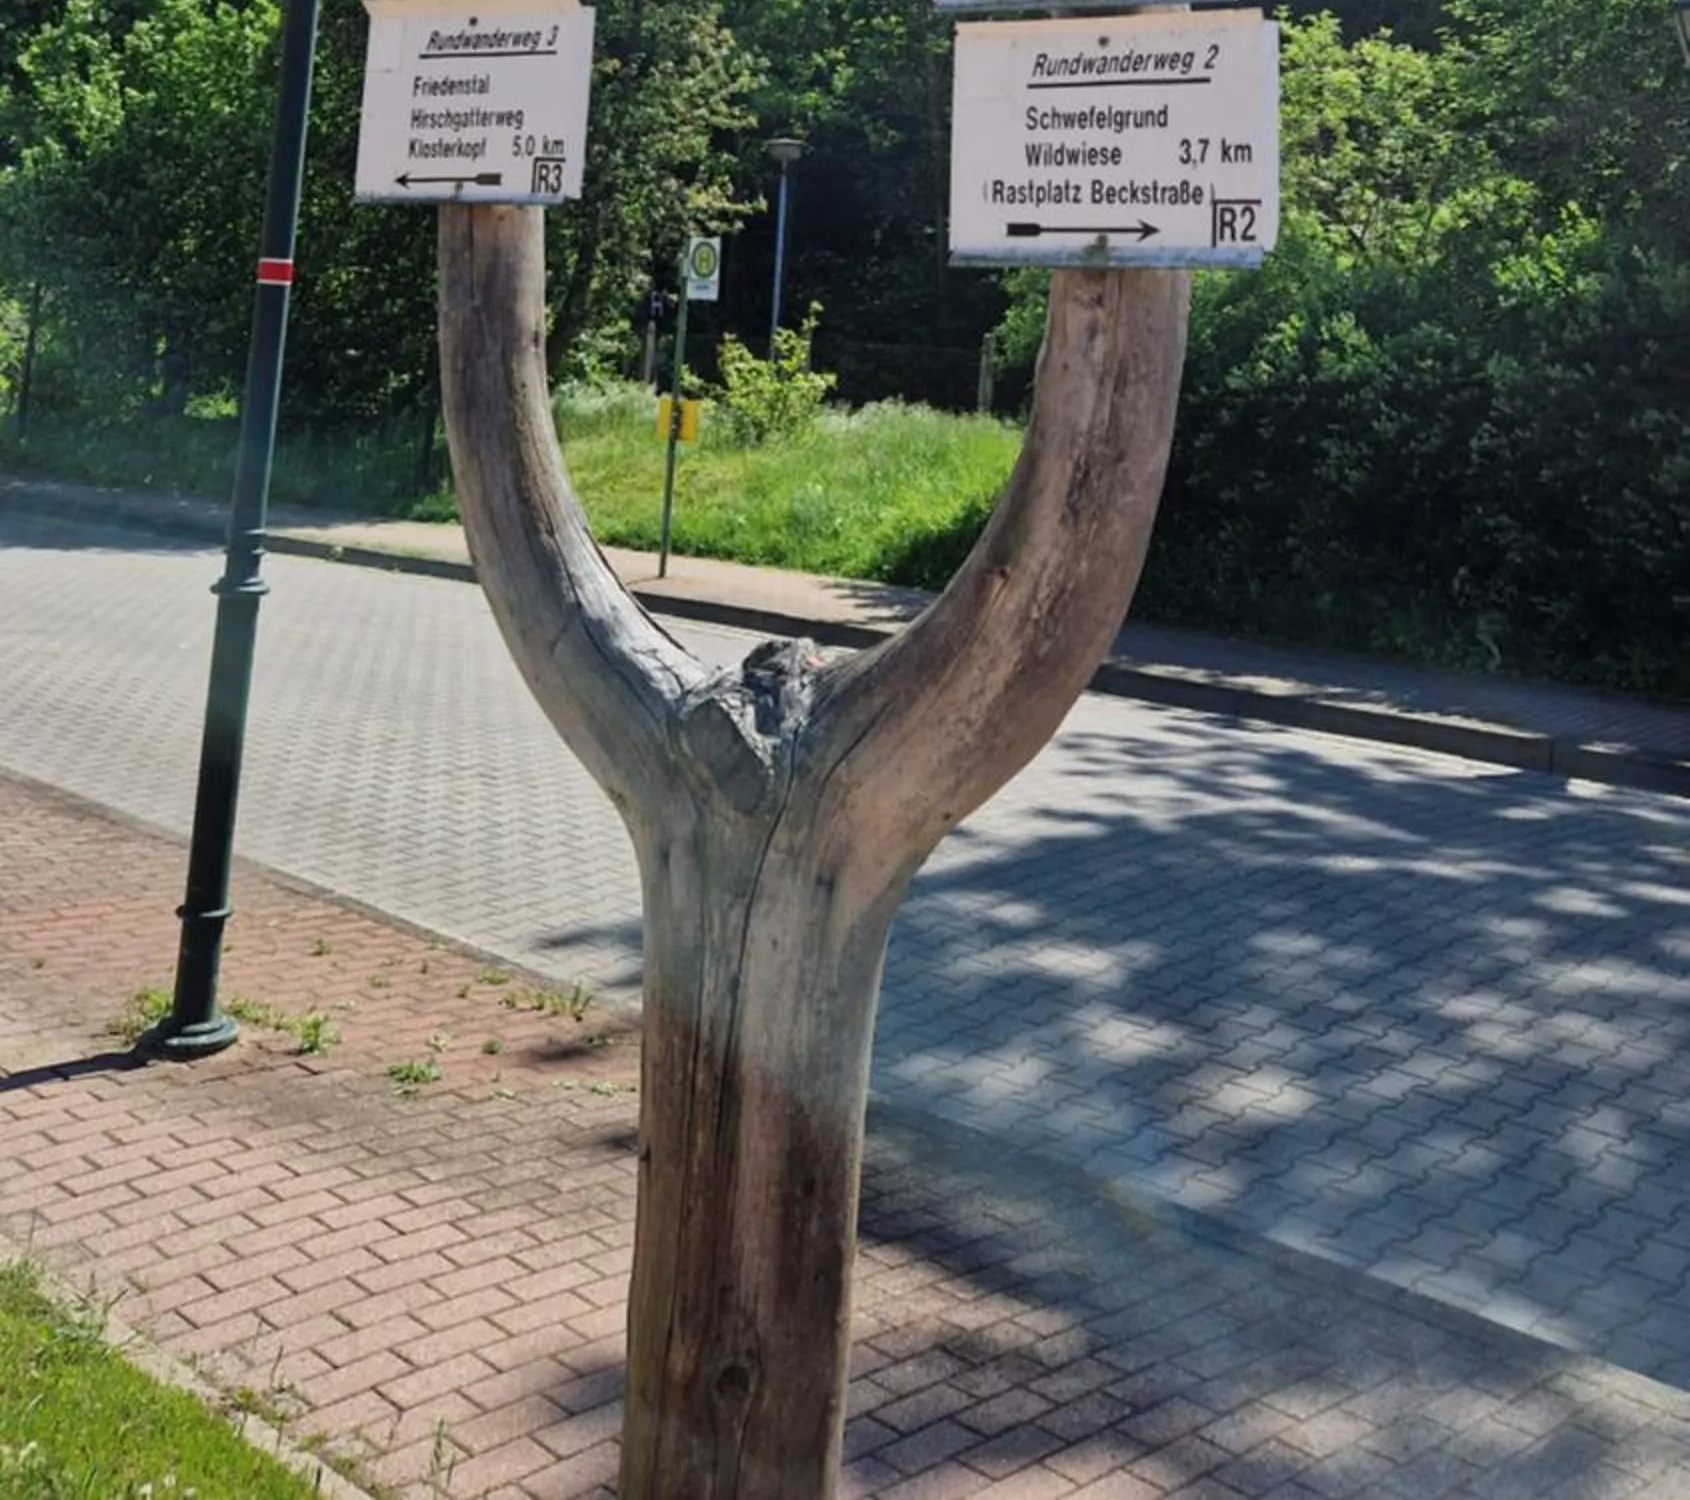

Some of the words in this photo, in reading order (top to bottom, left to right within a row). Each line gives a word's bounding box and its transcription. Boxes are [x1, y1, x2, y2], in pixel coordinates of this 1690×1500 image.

[427, 29, 541, 50] Rundwanderweg
[548, 25, 559, 47] 3
[1032, 50, 1194, 77] Rundwanderweg
[1204, 44, 1219, 69] 2
[413, 75, 490, 97] Friedenstal
[410, 109, 524, 132] Hirschgatterweg
[1026, 105, 1168, 133] Schwefelgrund
[408, 138, 486, 160] Klosterkopf
[512, 135, 535, 158] 5,0
[542, 135, 564, 155] km
[1026, 142, 1122, 166] Wildwiese
[1179, 139, 1209, 169] 3,7
[1221, 139, 1252, 164] km
[538, 164, 562, 193] R3
[1219, 207, 1256, 242] R2
